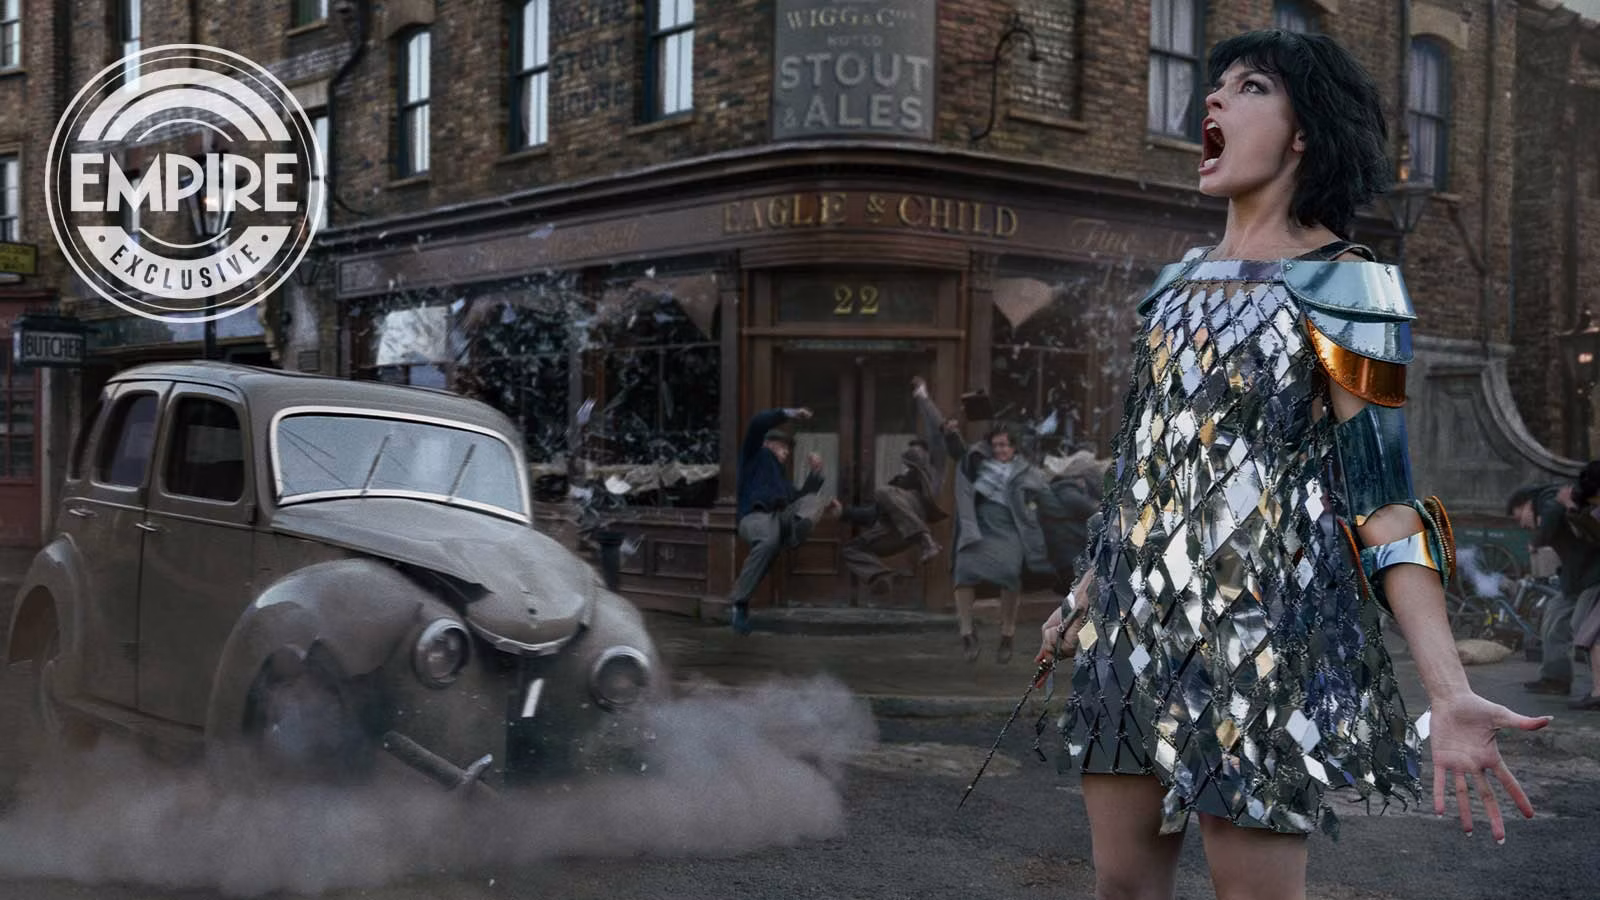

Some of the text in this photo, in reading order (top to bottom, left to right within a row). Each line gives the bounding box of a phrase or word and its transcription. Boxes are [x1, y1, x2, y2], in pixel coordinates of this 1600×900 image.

[780, 52, 929, 91] STOUT
[783, 93, 924, 131] & ALES
[722, 193, 1019, 237] EAGLE & CHILD
[833, 285, 880, 315] 22
[25, 335, 82, 359] BUTCHER
